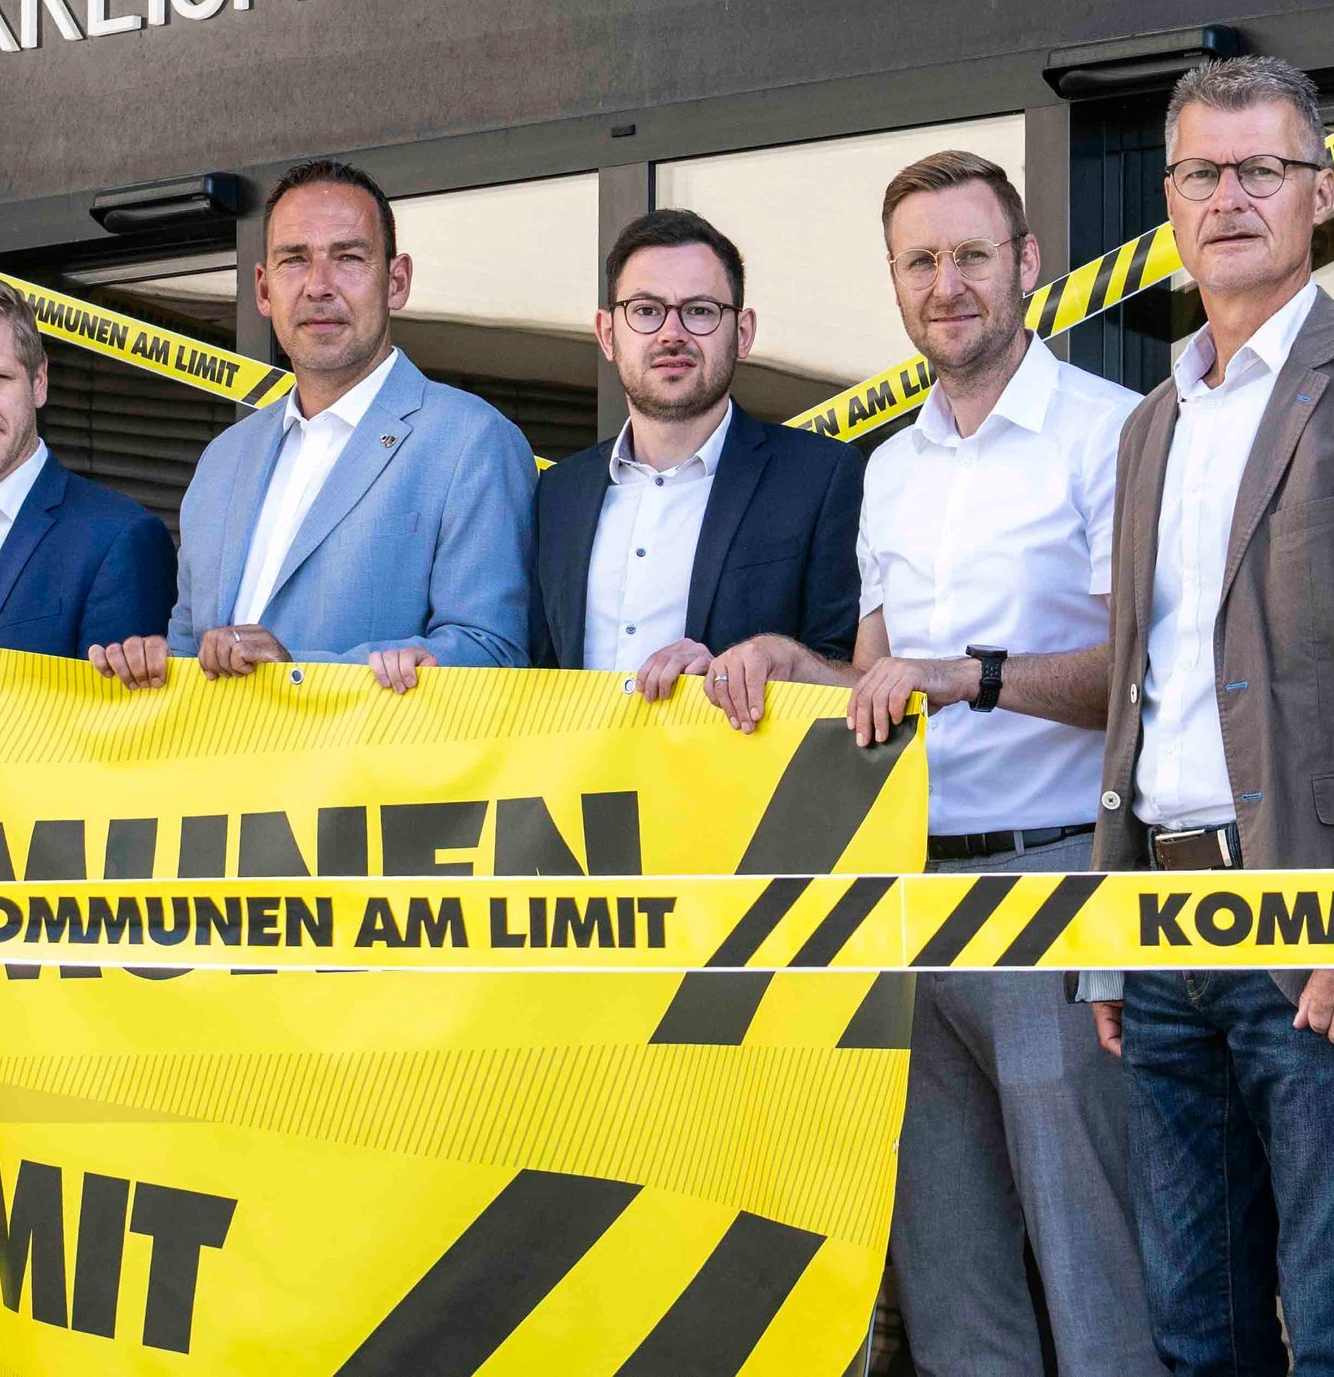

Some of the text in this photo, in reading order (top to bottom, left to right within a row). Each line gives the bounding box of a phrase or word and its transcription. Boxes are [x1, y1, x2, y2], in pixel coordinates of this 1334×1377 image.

[17, 288, 130, 351] MMUNEN
[131, 332, 171, 367] AM
[174, 345, 241, 389] LIMIT
[848, 380, 898, 429] AM
[354, 896, 470, 948] AM
[489, 896, 677, 949] LIMIT
